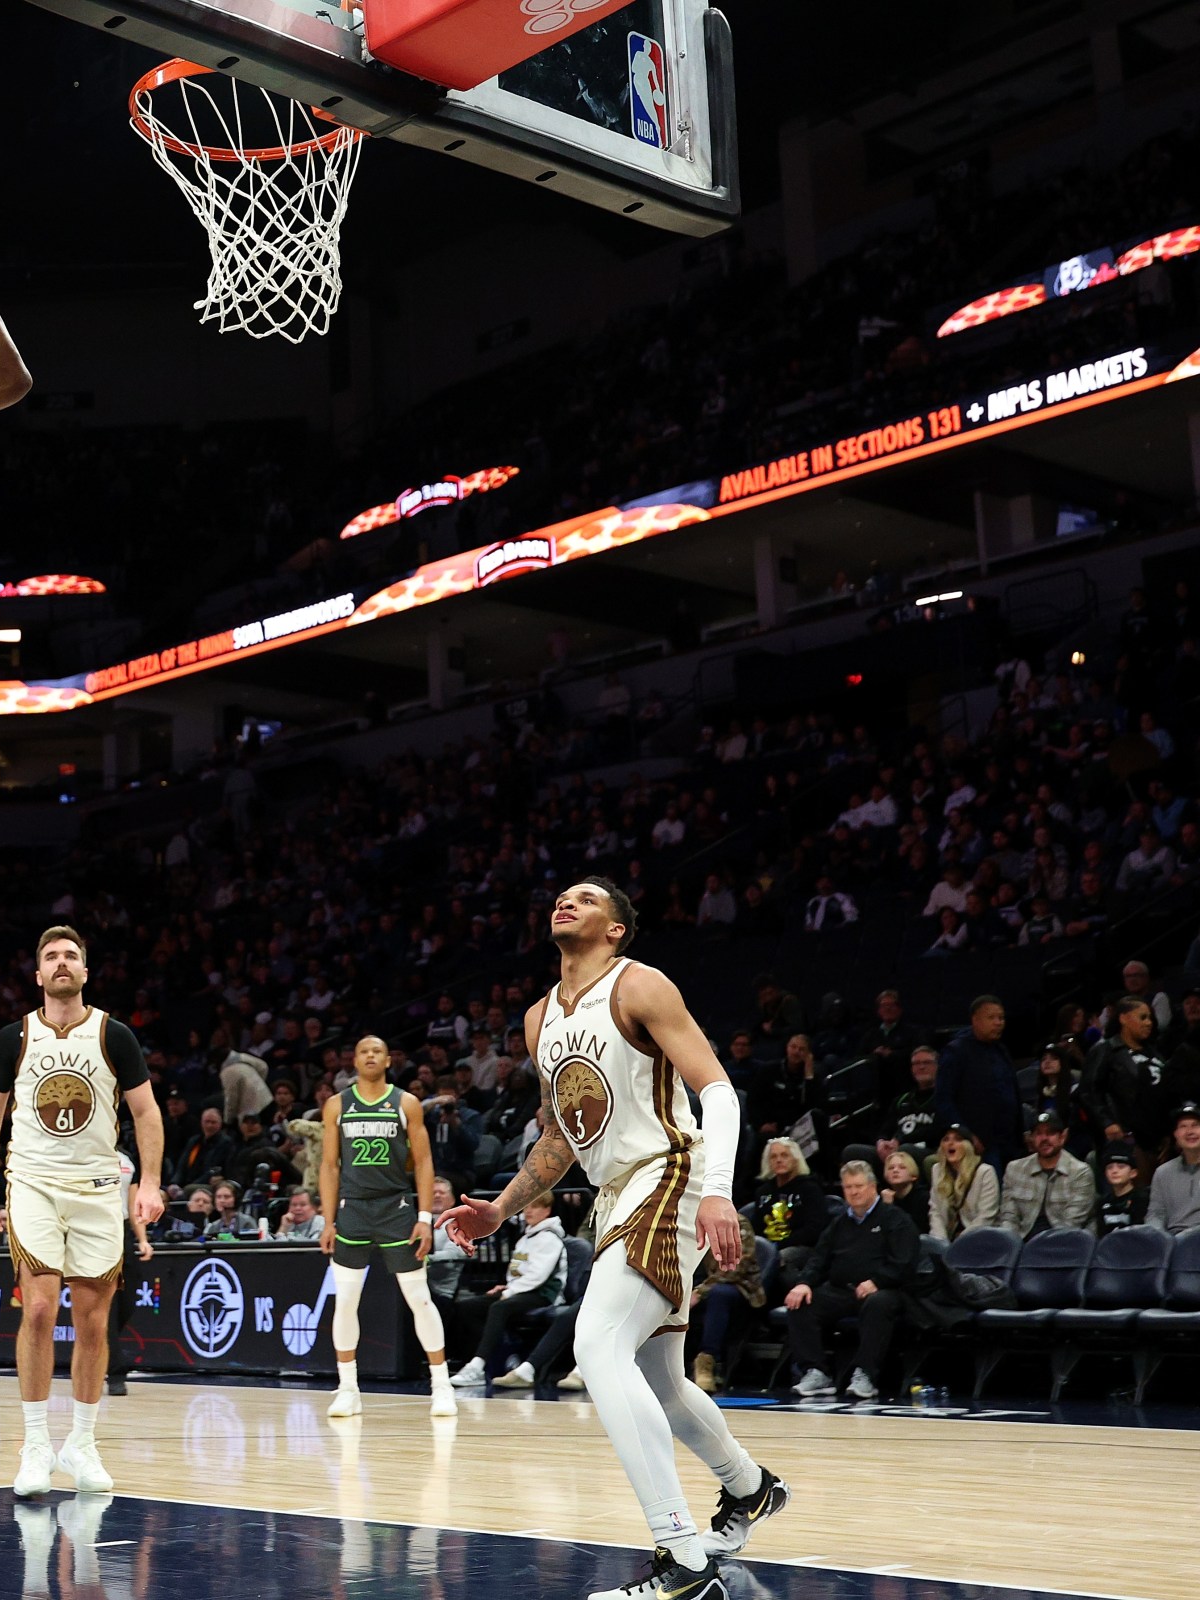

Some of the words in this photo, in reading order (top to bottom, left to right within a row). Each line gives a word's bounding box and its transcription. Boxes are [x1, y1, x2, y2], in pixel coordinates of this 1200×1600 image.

[637, 118, 655, 141] NBA
[719, 452, 810, 503] AVAILABLE
[811, 445, 833, 475] IN
[837, 416, 924, 468] SECTIONS
[928, 405, 962, 439] 131
[987, 380, 1043, 422] MPLS
[1046, 347, 1148, 404] MARKETS
[85, 664, 128, 693] OFFICIAL
[128, 653, 161, 680] PIZZA
[161, 648, 177, 671] OF
[176, 641, 198, 666] THE
[27, 1051, 98, 1078] TOWN
[542, 1029, 607, 1074] TOWN
[56, 1108, 75, 1131] 61
[341, 1121, 399, 1138] TIMBERWOLVES
[575, 1109, 586, 1140] 3
[351, 1138, 390, 1166] 22
[254, 1296, 275, 1333] VS
